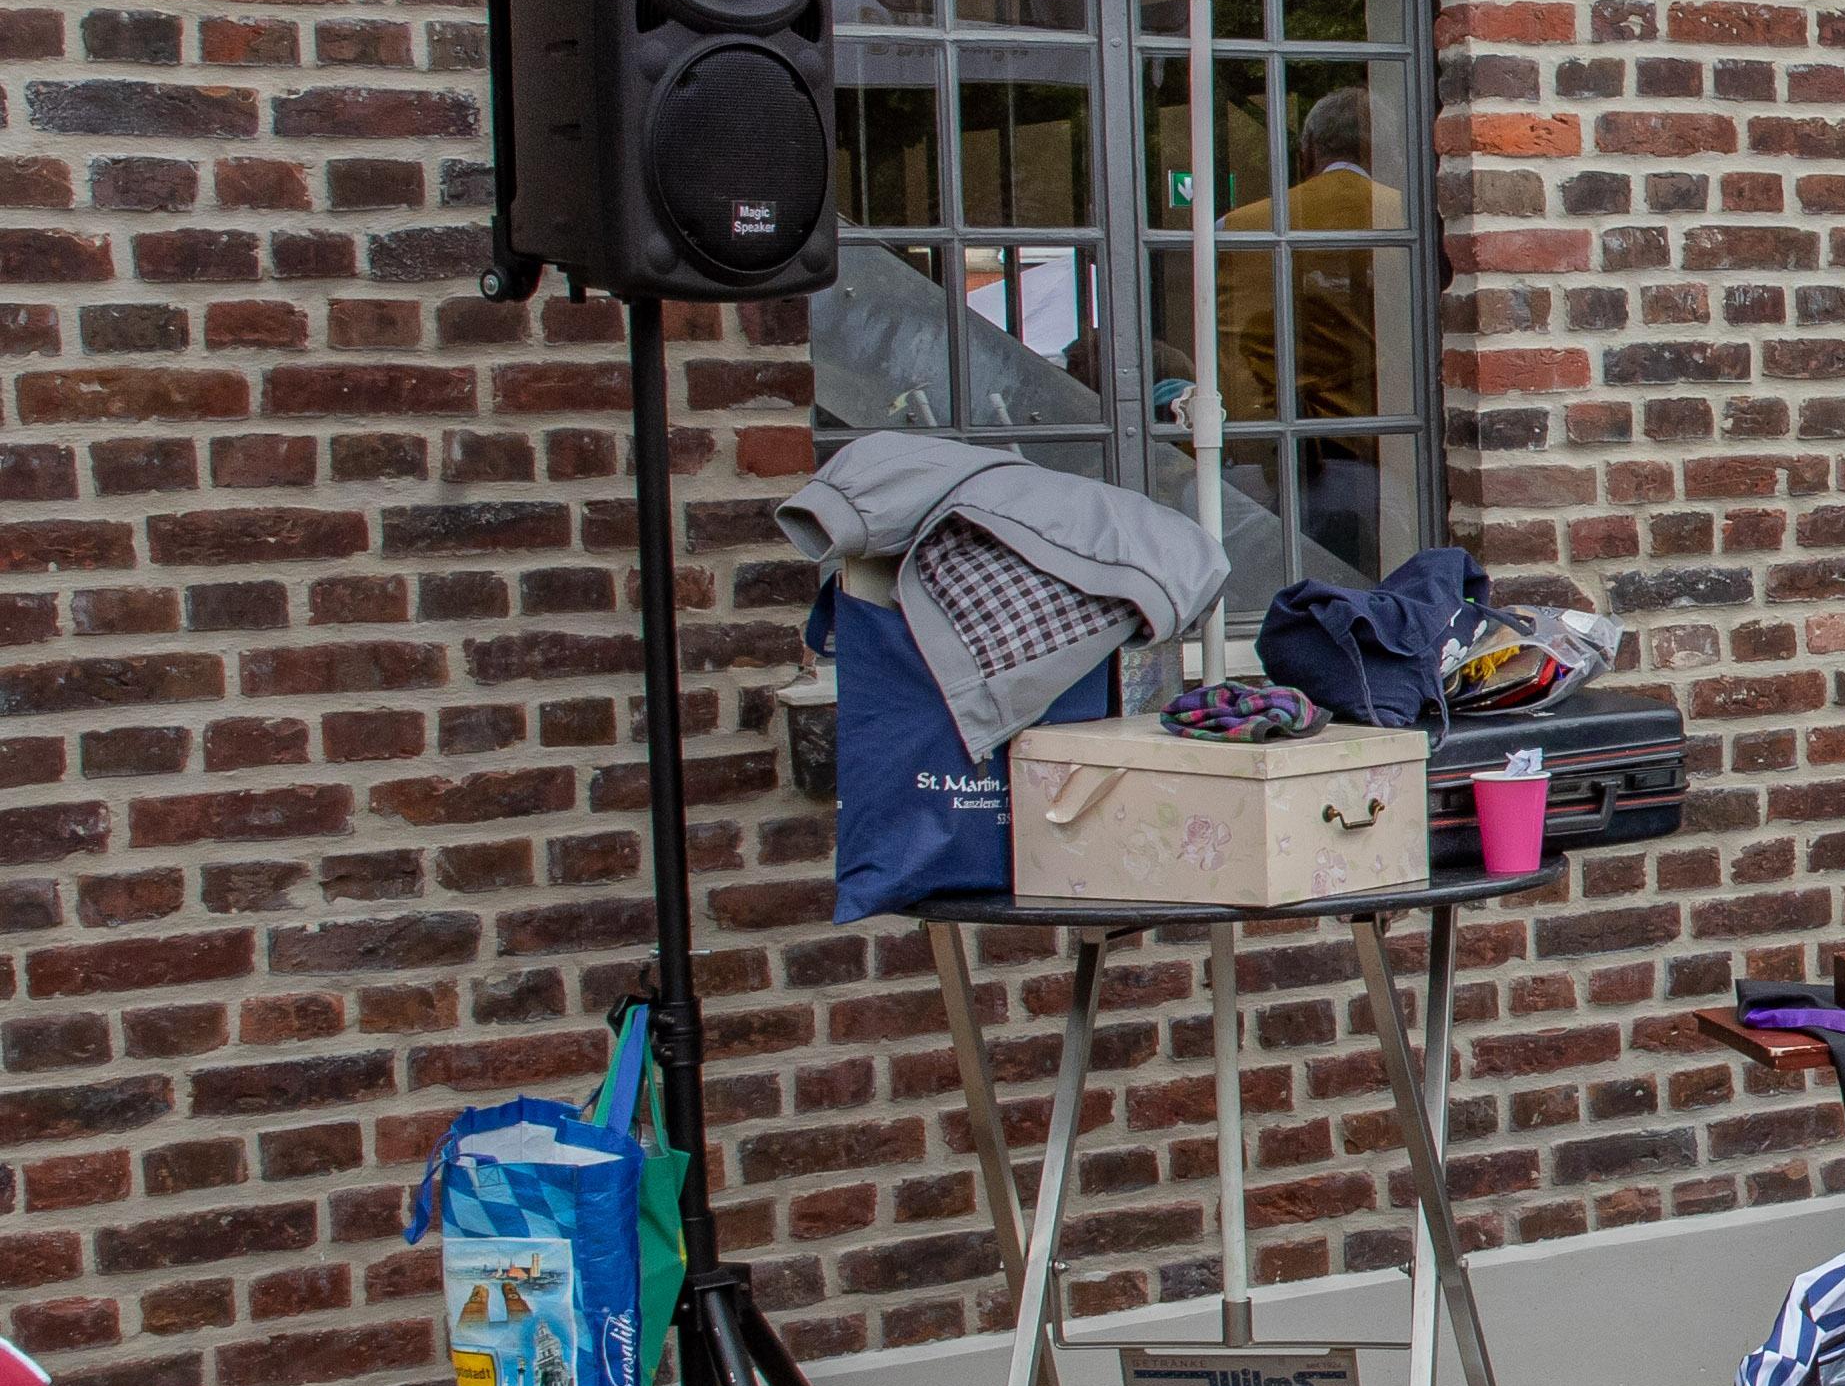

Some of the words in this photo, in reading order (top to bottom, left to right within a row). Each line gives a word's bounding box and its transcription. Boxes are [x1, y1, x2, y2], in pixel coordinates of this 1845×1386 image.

[739, 205, 770, 220] Magic
[733, 220, 776, 235] Speaker
[916, 772, 940, 790] St.
[944, 775, 1000, 792] Martin
